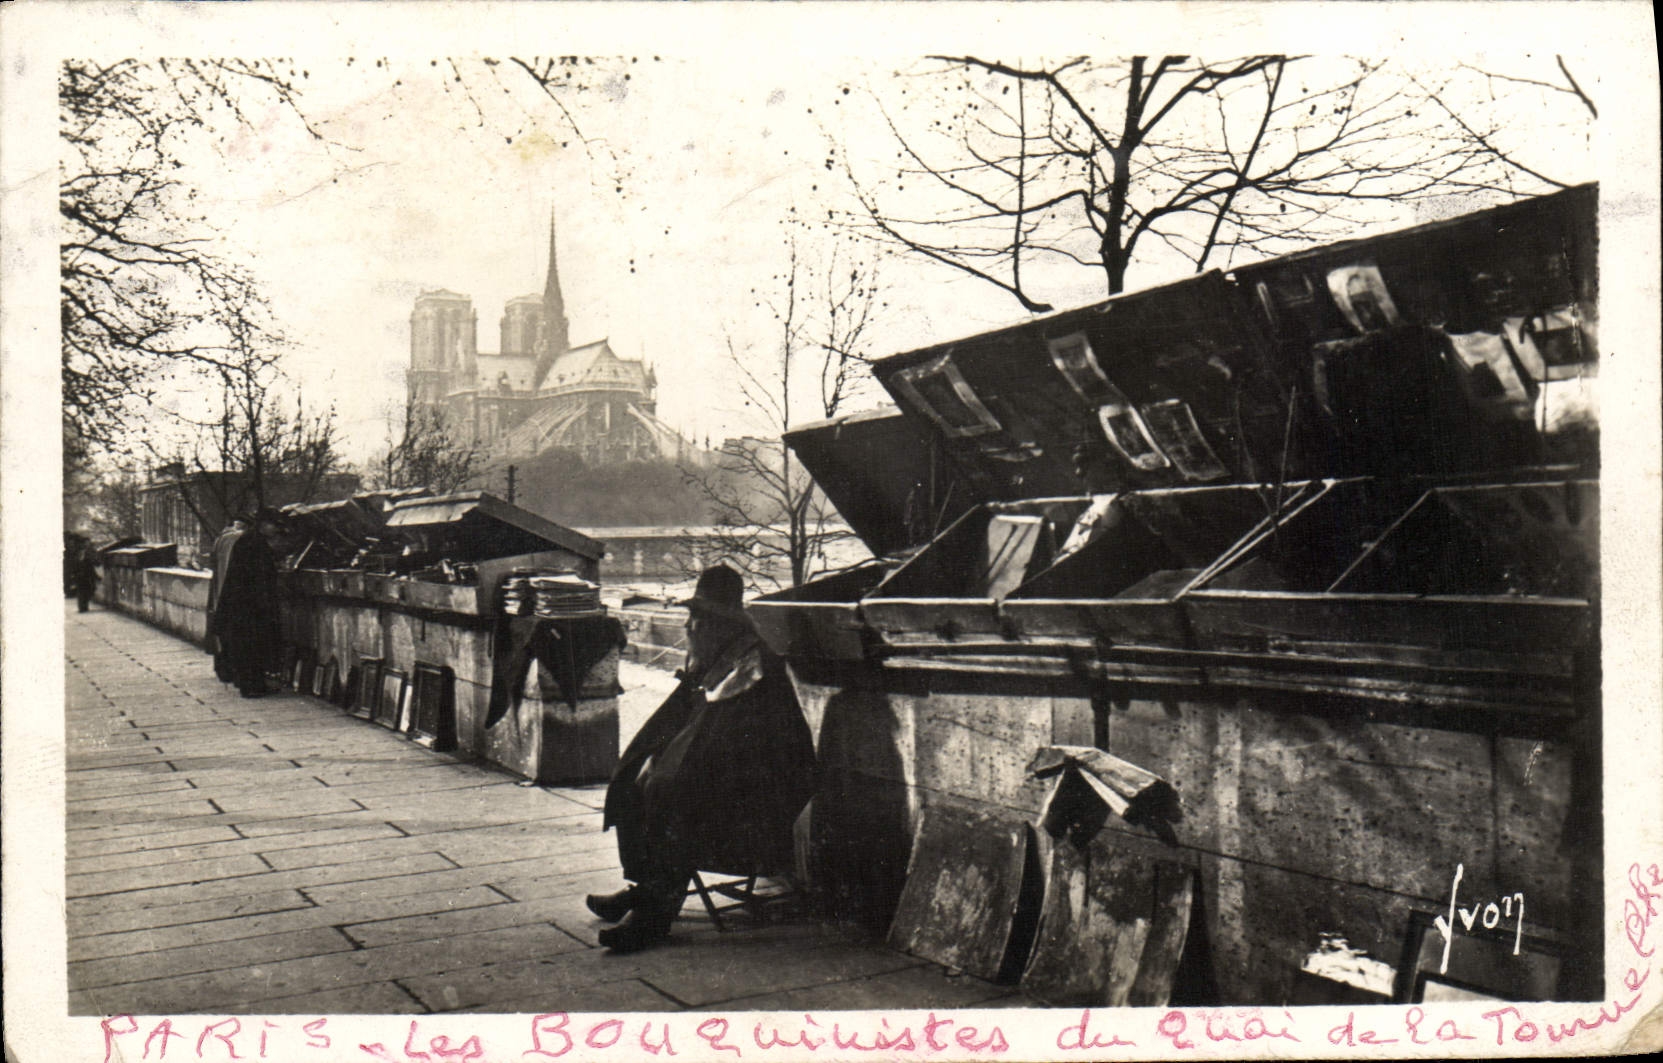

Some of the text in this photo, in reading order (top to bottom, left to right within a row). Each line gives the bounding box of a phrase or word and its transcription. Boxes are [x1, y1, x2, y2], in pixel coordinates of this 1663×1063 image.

[403, 1019, 486, 1060] Les
[1056, 1008, 1137, 1050] du
[1156, 1009, 1303, 1051] Quai
[1327, 1012, 1400, 1047] de
